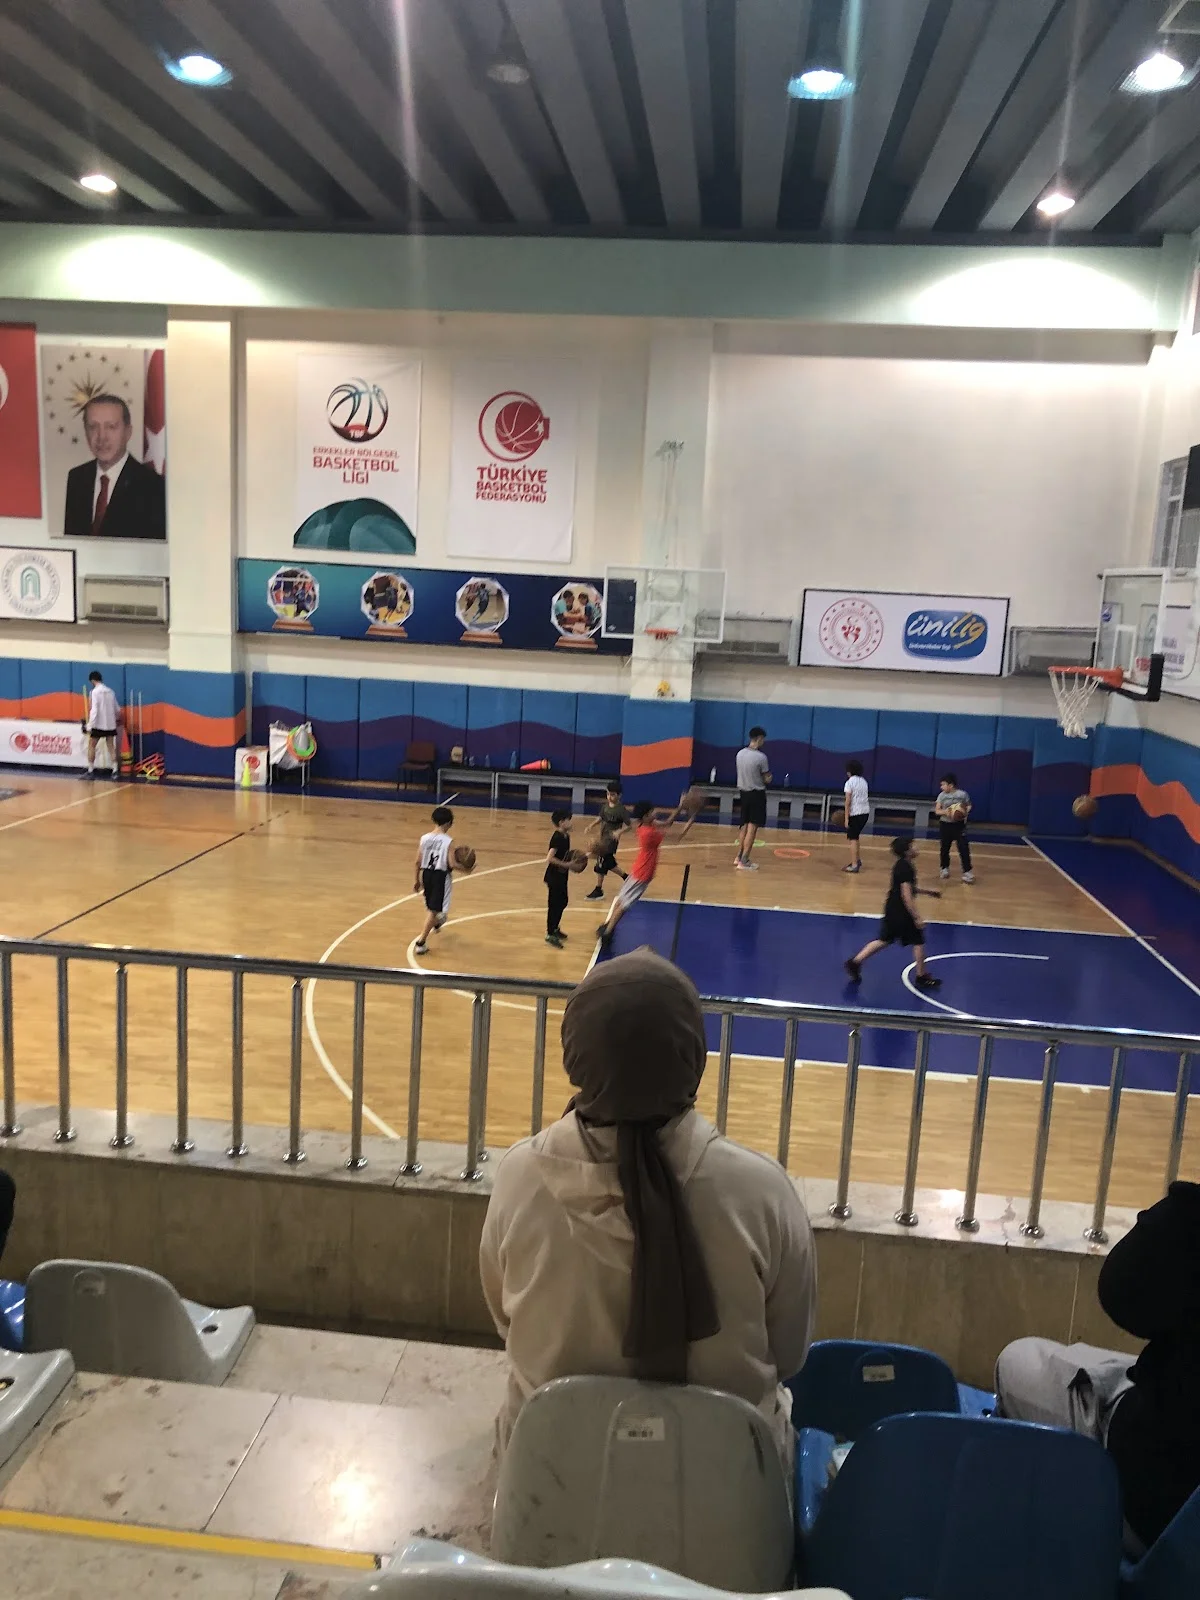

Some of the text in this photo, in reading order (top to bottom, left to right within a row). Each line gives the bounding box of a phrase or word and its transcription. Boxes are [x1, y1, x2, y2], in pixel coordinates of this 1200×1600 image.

[313, 456, 399, 472] BASKETBOL
[477, 463, 548, 483] TÜRKİYE
[476, 481, 547, 494] BASKETBOL
[475, 491, 547, 504] FEDERASYONU
